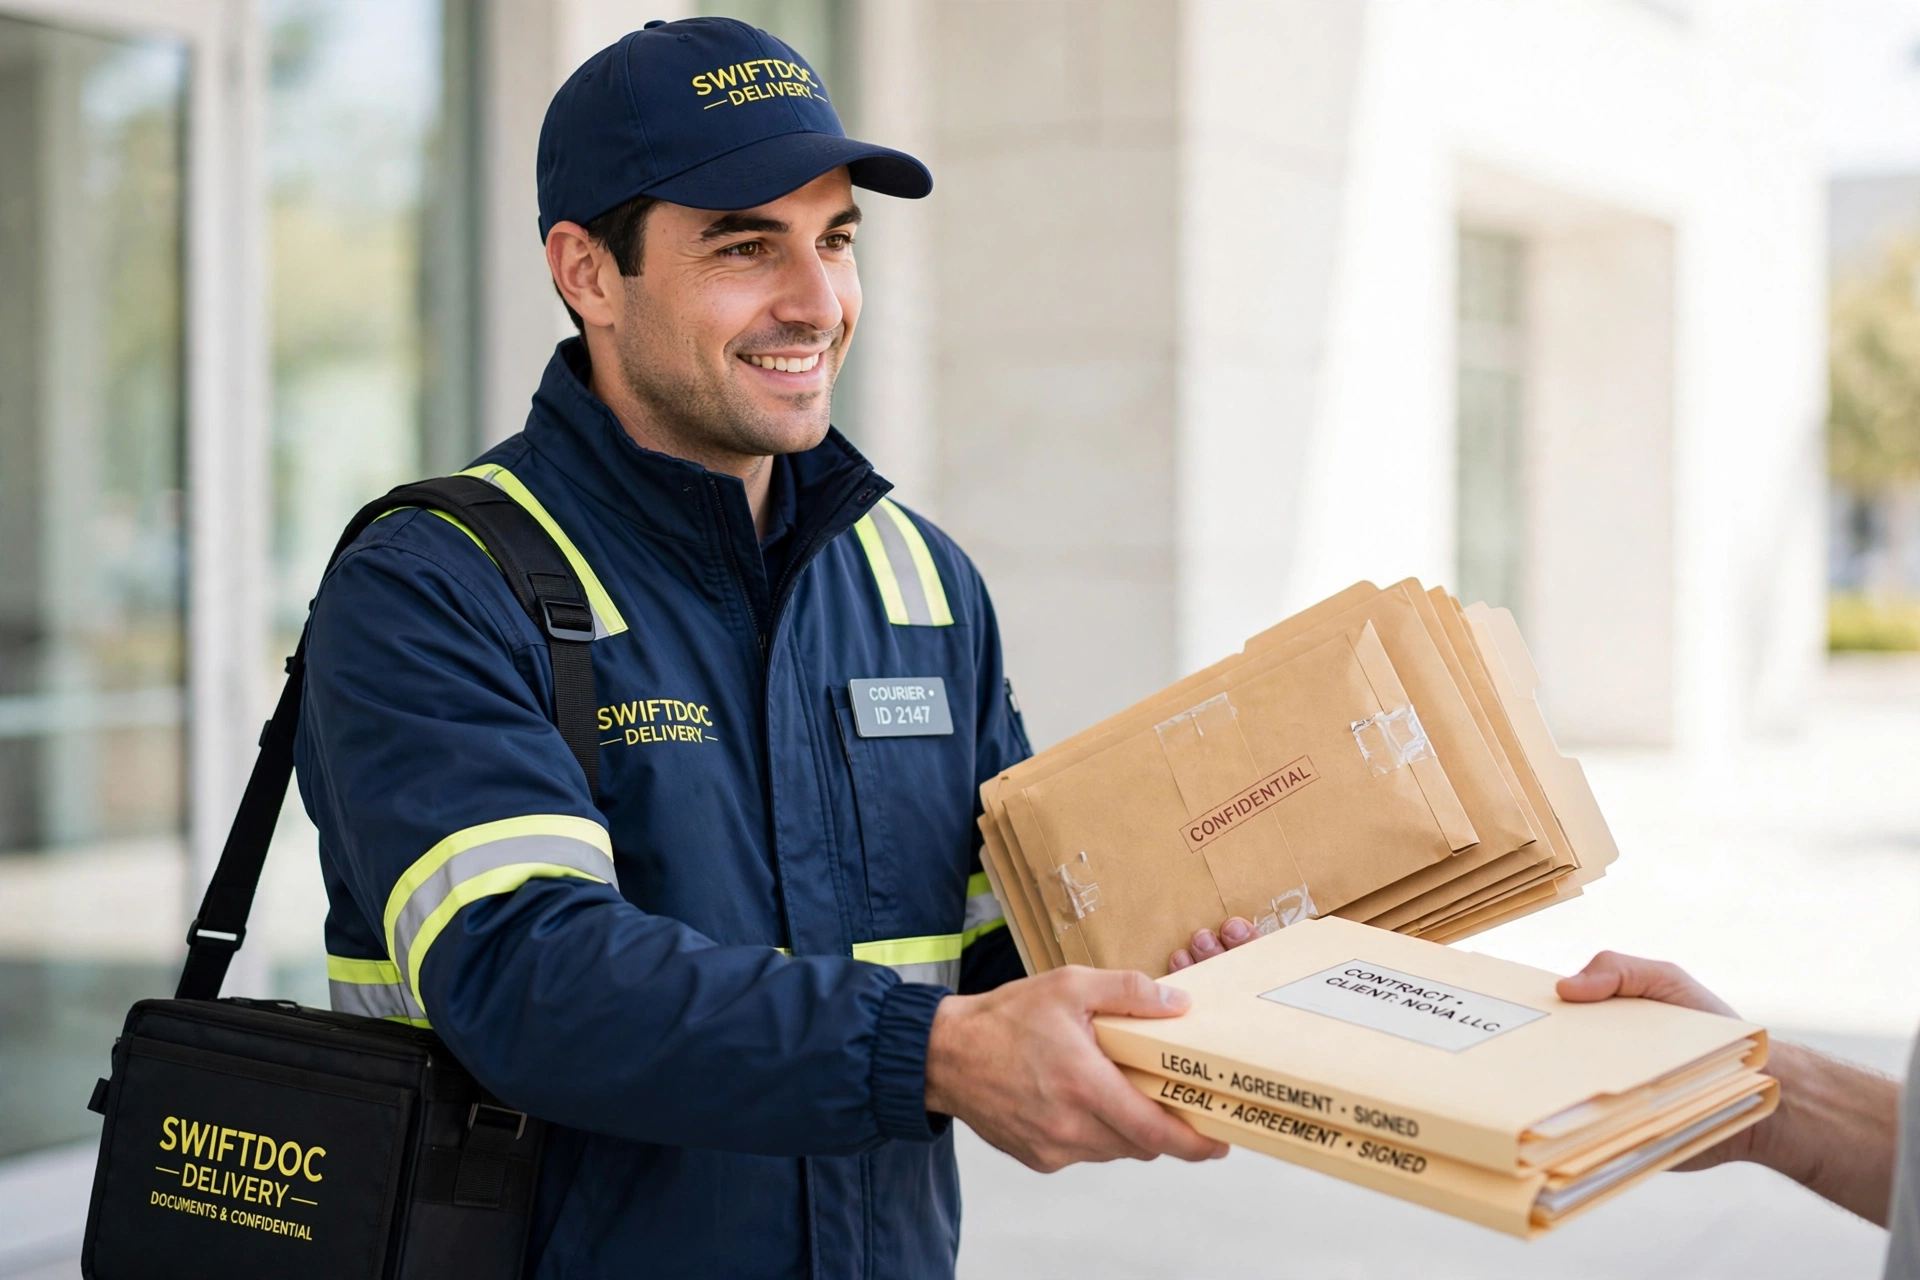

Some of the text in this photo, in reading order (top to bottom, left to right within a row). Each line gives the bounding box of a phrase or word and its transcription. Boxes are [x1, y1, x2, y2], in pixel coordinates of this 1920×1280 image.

[692, 59, 818, 96] SWIFTDOC
[728, 82, 813, 106] DELIVERY
[869, 686, 926, 701] COURIER
[597, 699, 713, 730] SWIFTDOC
[625, 725, 703, 745] DELIVERY
[874, 705, 931, 725] ID 2147
[1190, 766, 1311, 842] CONFIDENTIAL
[1325, 977, 1500, 1032] CLIENT: NOVA LLC
[1344, 968, 1454, 1002] CONTRACT
[1161, 1052, 1419, 1138] LEGAL AGREEMENT SIGNED
[1160, 1081, 1427, 1174] LEGAL AGREEMENT SIGNED
[159, 1116, 327, 1183] SWIFTDOC
[182, 1162, 290, 1208] DELIVERY
[150, 1191, 313, 1241] DOCUMENTS & CONFIDENTIAL
